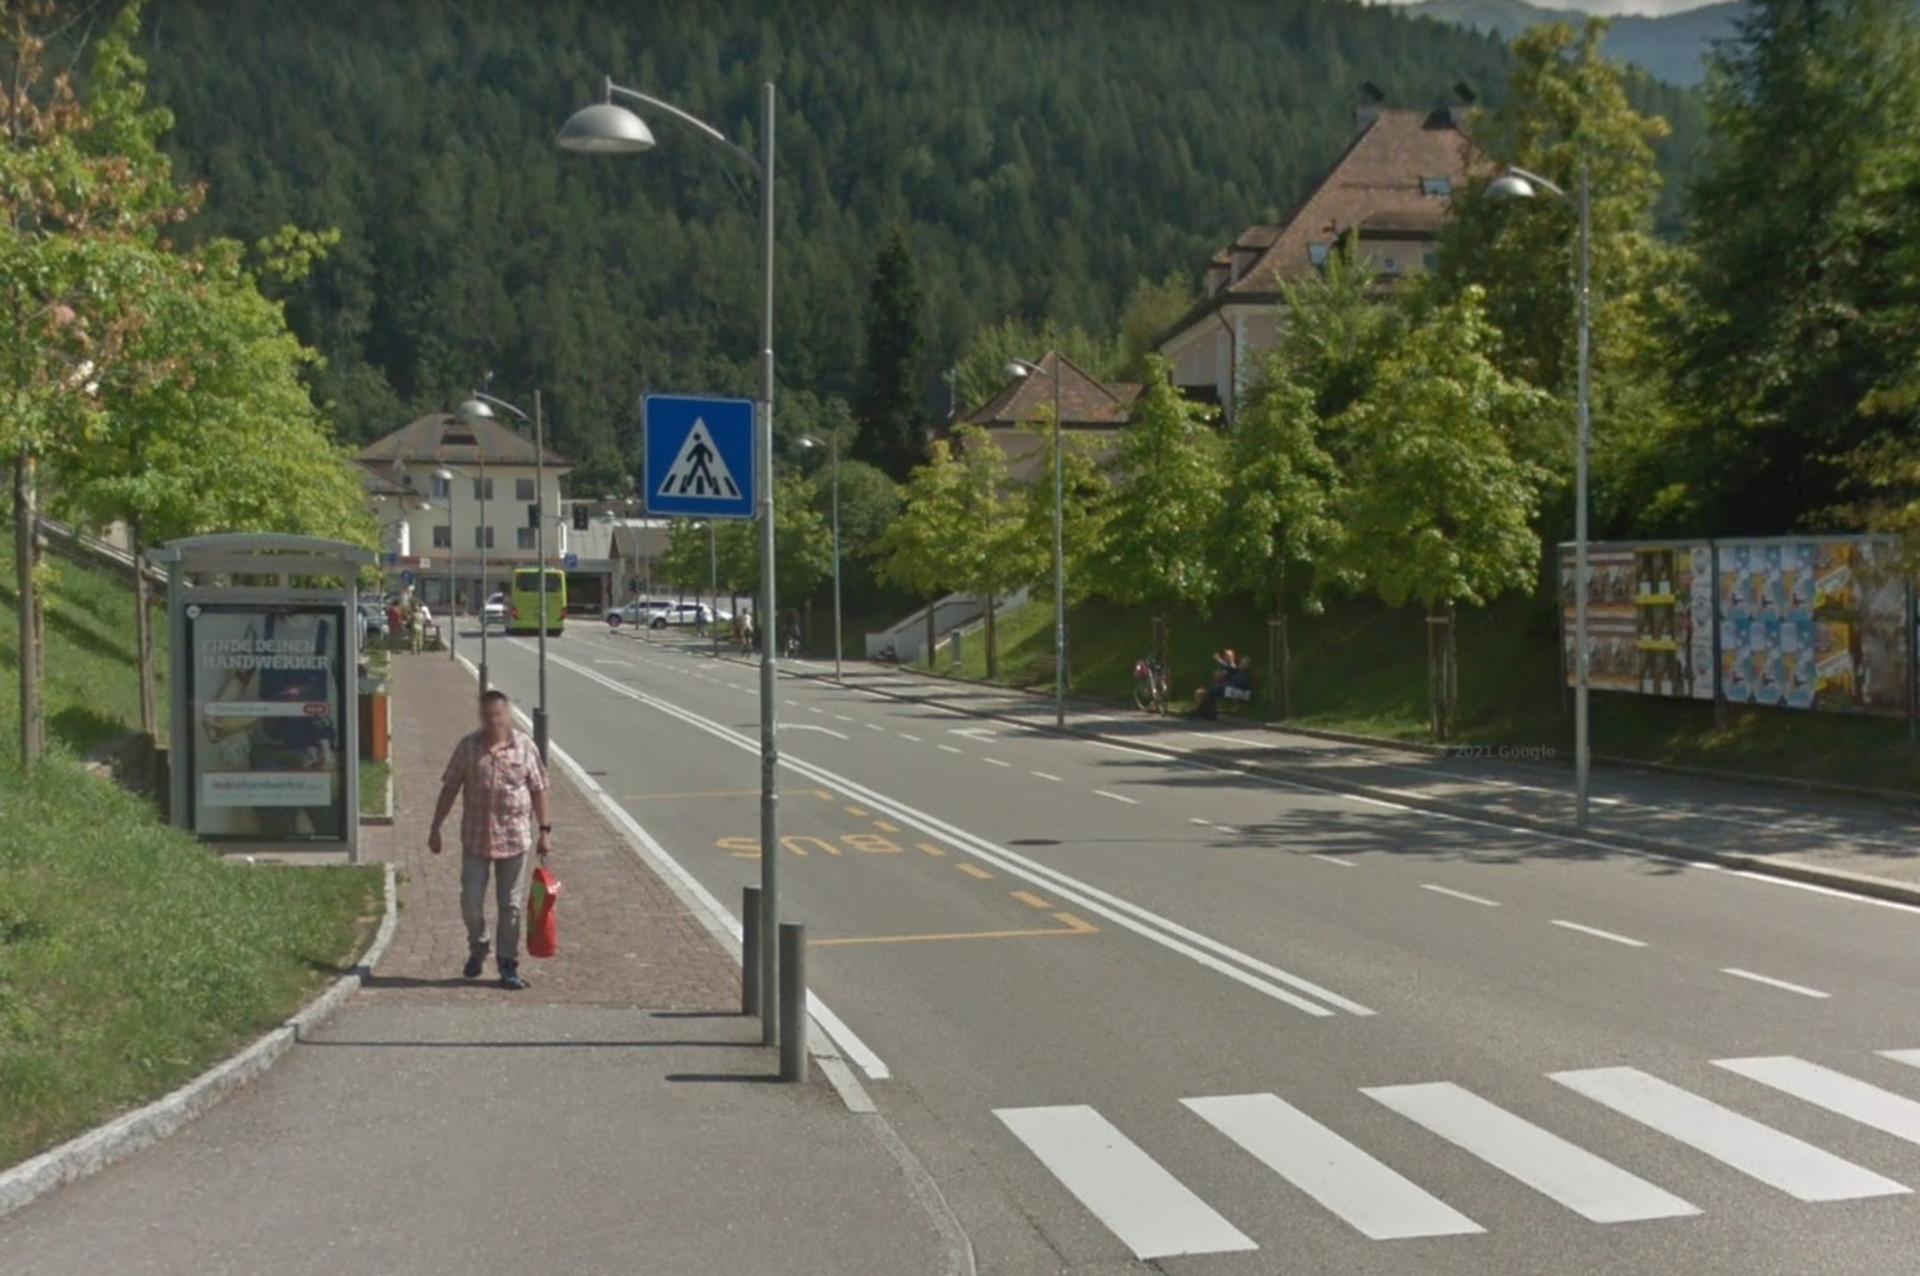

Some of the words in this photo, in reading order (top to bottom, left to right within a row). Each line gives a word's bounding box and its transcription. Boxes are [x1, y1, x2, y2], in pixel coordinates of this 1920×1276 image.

[202, 639, 252, 653] FINDE
[256, 639, 316, 653] DEINEN
[202, 655, 329, 669] HANDWERKER
[714, 834, 903, 859] BUS
